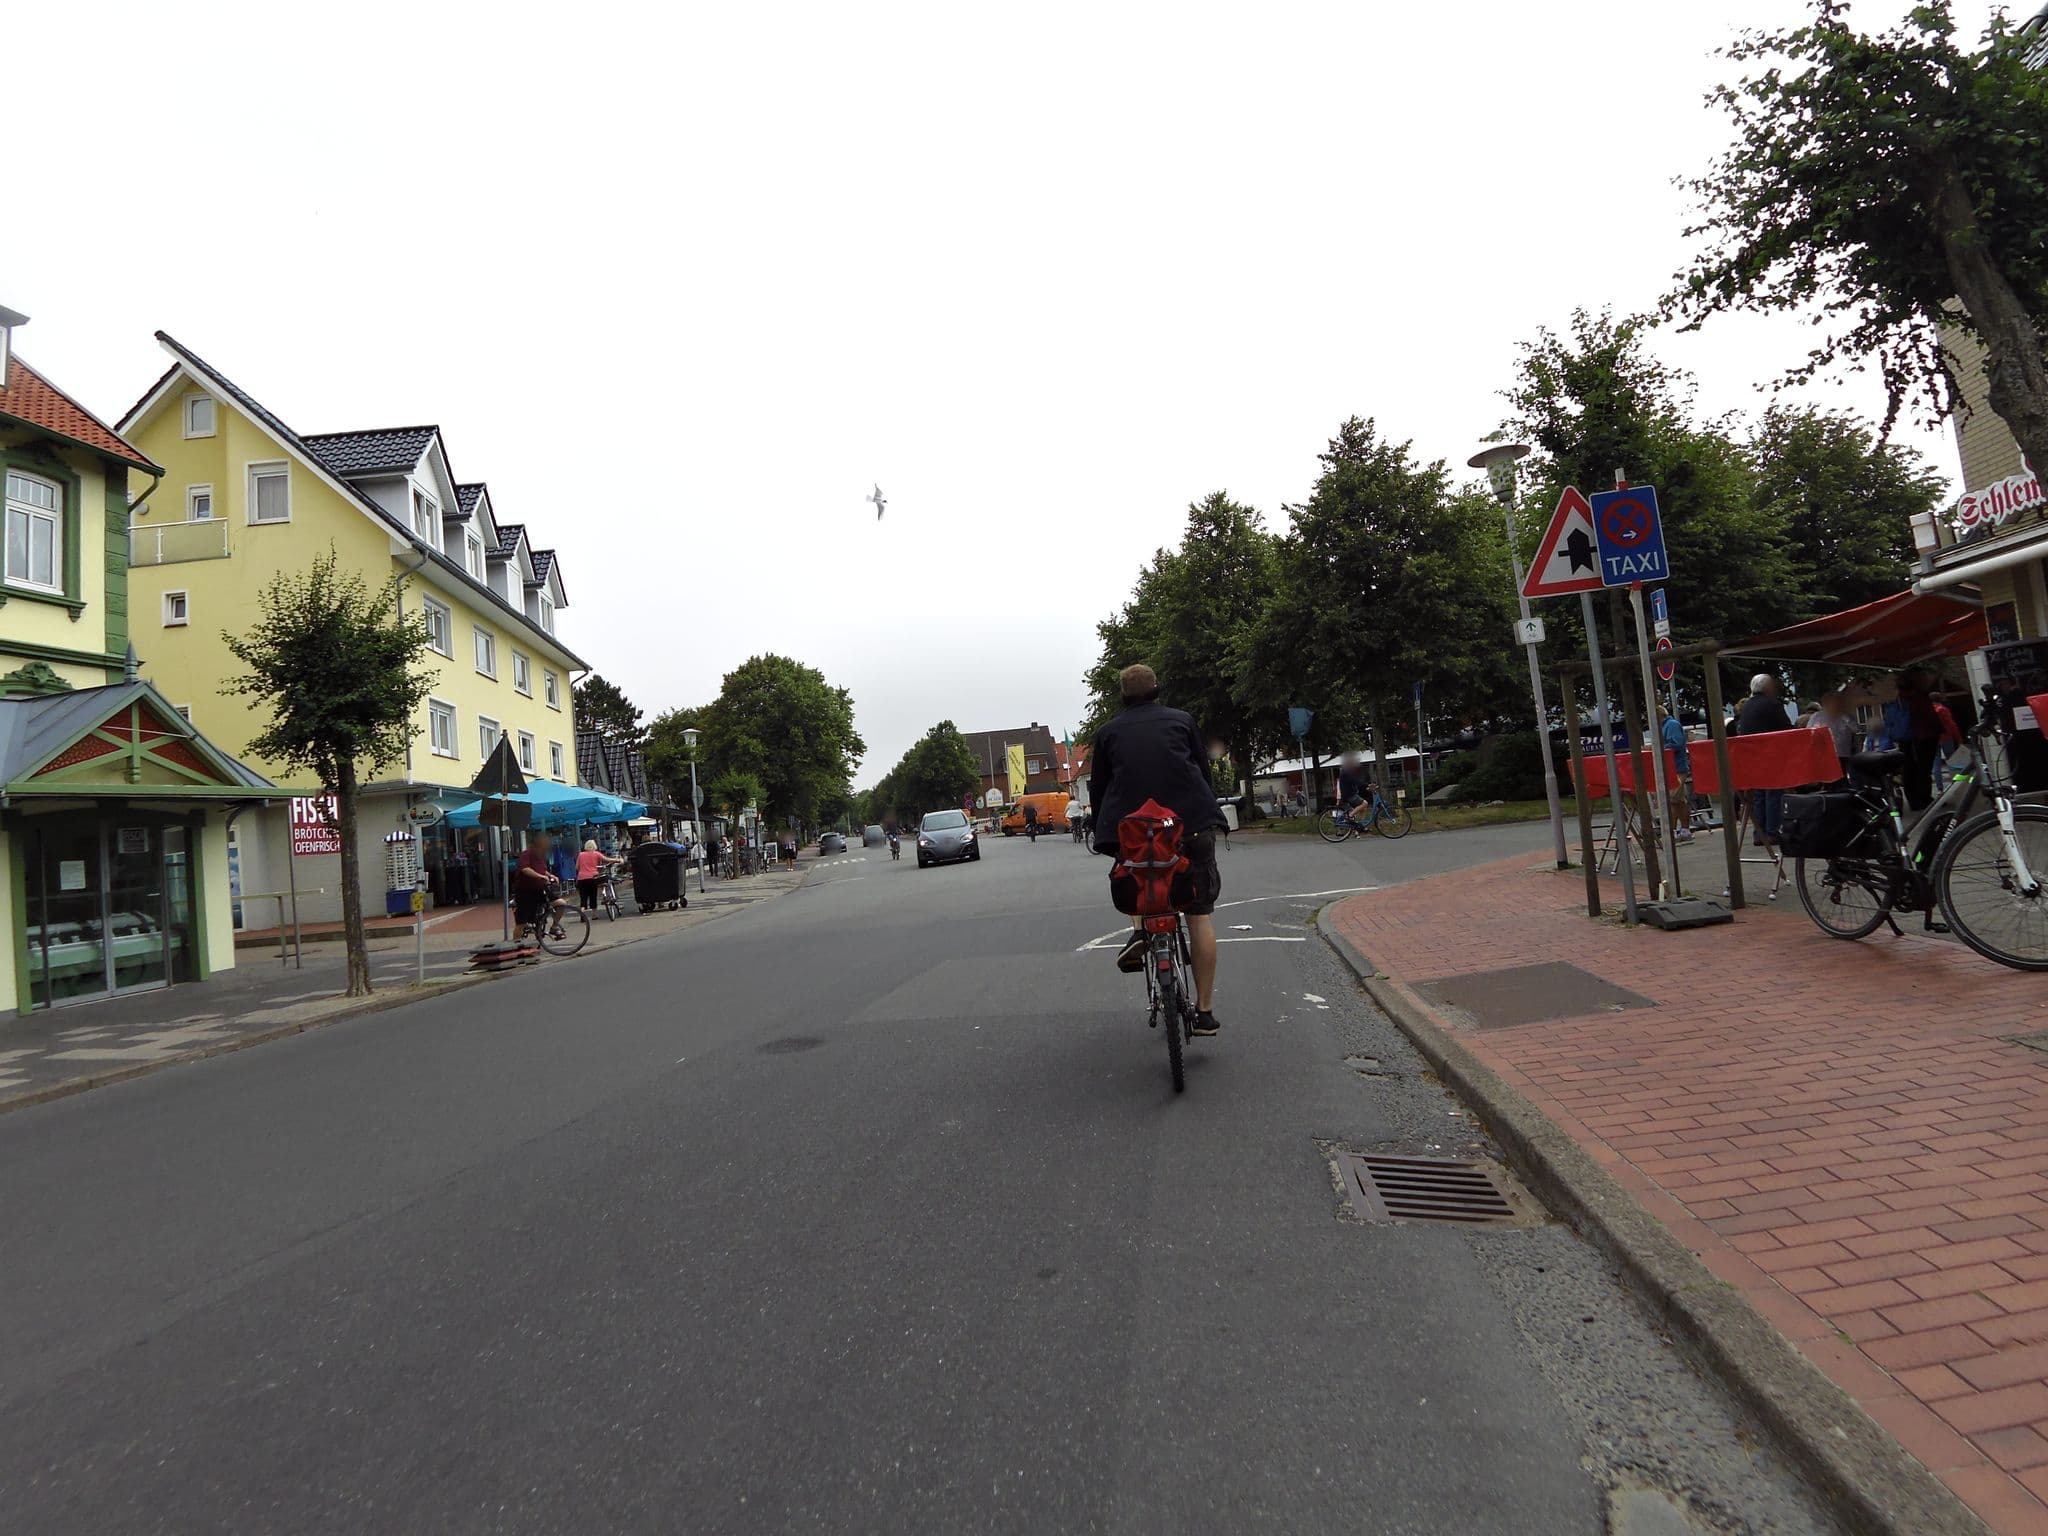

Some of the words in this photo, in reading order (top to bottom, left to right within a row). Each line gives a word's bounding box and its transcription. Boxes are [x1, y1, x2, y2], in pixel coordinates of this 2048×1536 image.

[1606, 551, 1660, 576] TAXI
[292, 796, 338, 824] FISCH
[295, 840, 340, 853] OFENFRISCH
